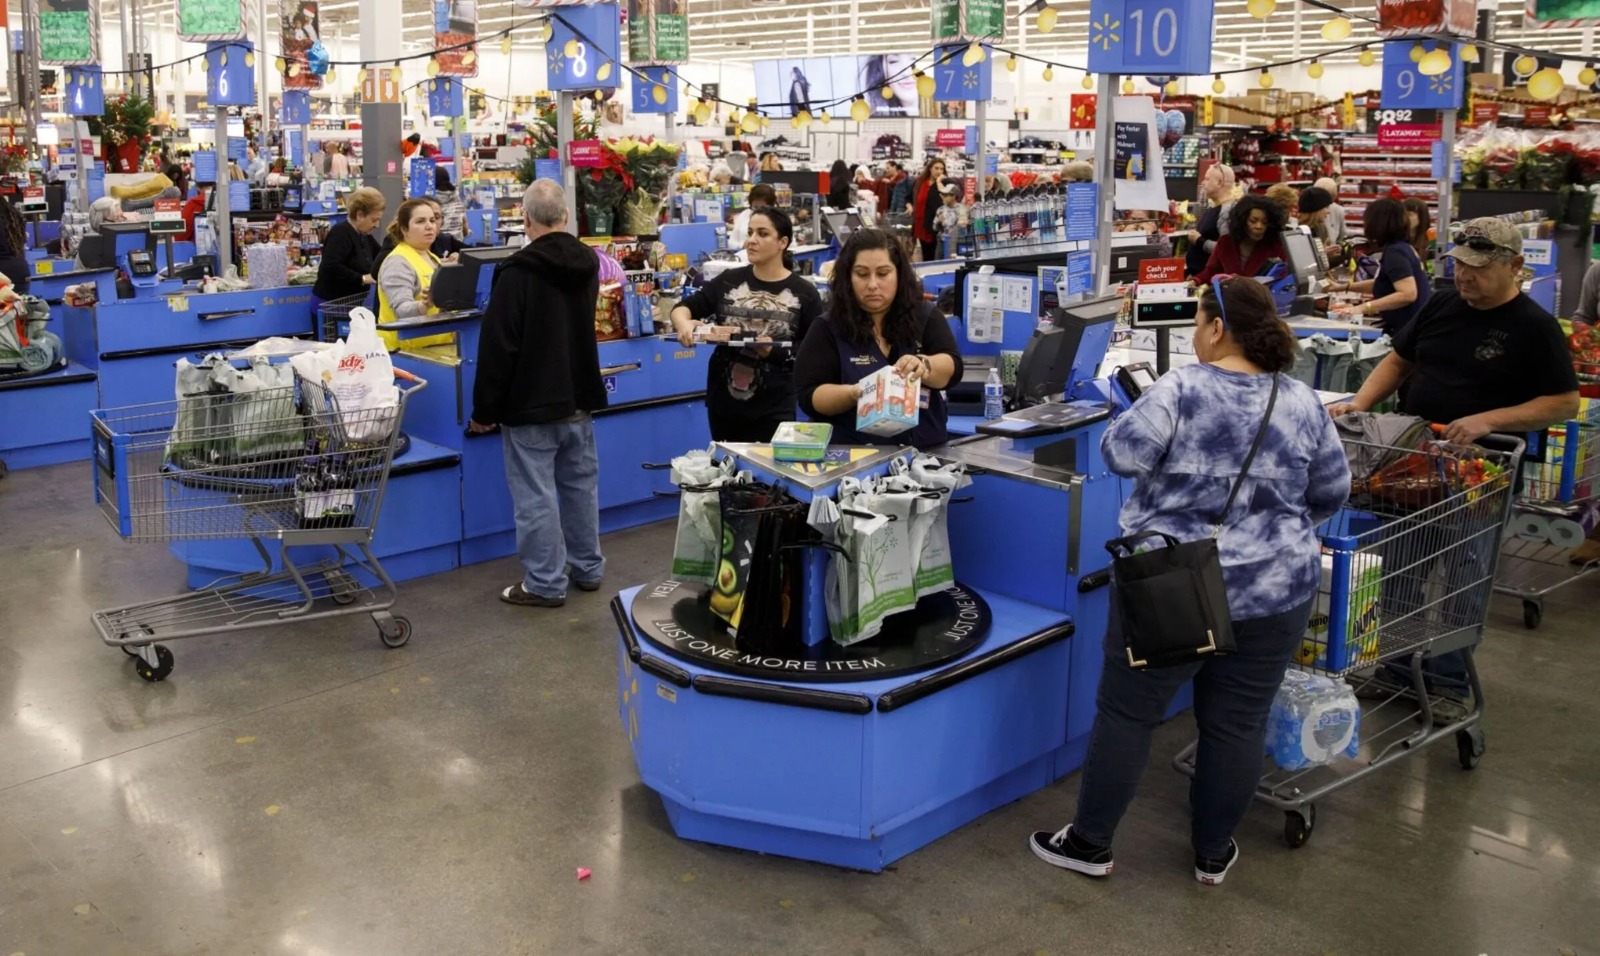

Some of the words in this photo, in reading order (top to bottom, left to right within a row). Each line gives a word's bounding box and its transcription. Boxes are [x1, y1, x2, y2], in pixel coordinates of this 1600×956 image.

[1129, 8, 1178, 57] 10
[573, 42, 587, 78] 8
[219, 70, 228, 97] 6
[944, 70, 955, 93] 7
[1397, 70, 1415, 100] 9
[75, 87, 83, 110] 4
[434, 96, 440, 112] 3
[640, 88, 648, 107] 5
[956, 601, 978, 619] ONE
[944, 620, 976, 640] JUST
[656, 622, 695, 640] JUST
[689, 640, 738, 660] ONE
[738, 654, 817, 670] MORE
[826, 657, 886, 670] ITEM
